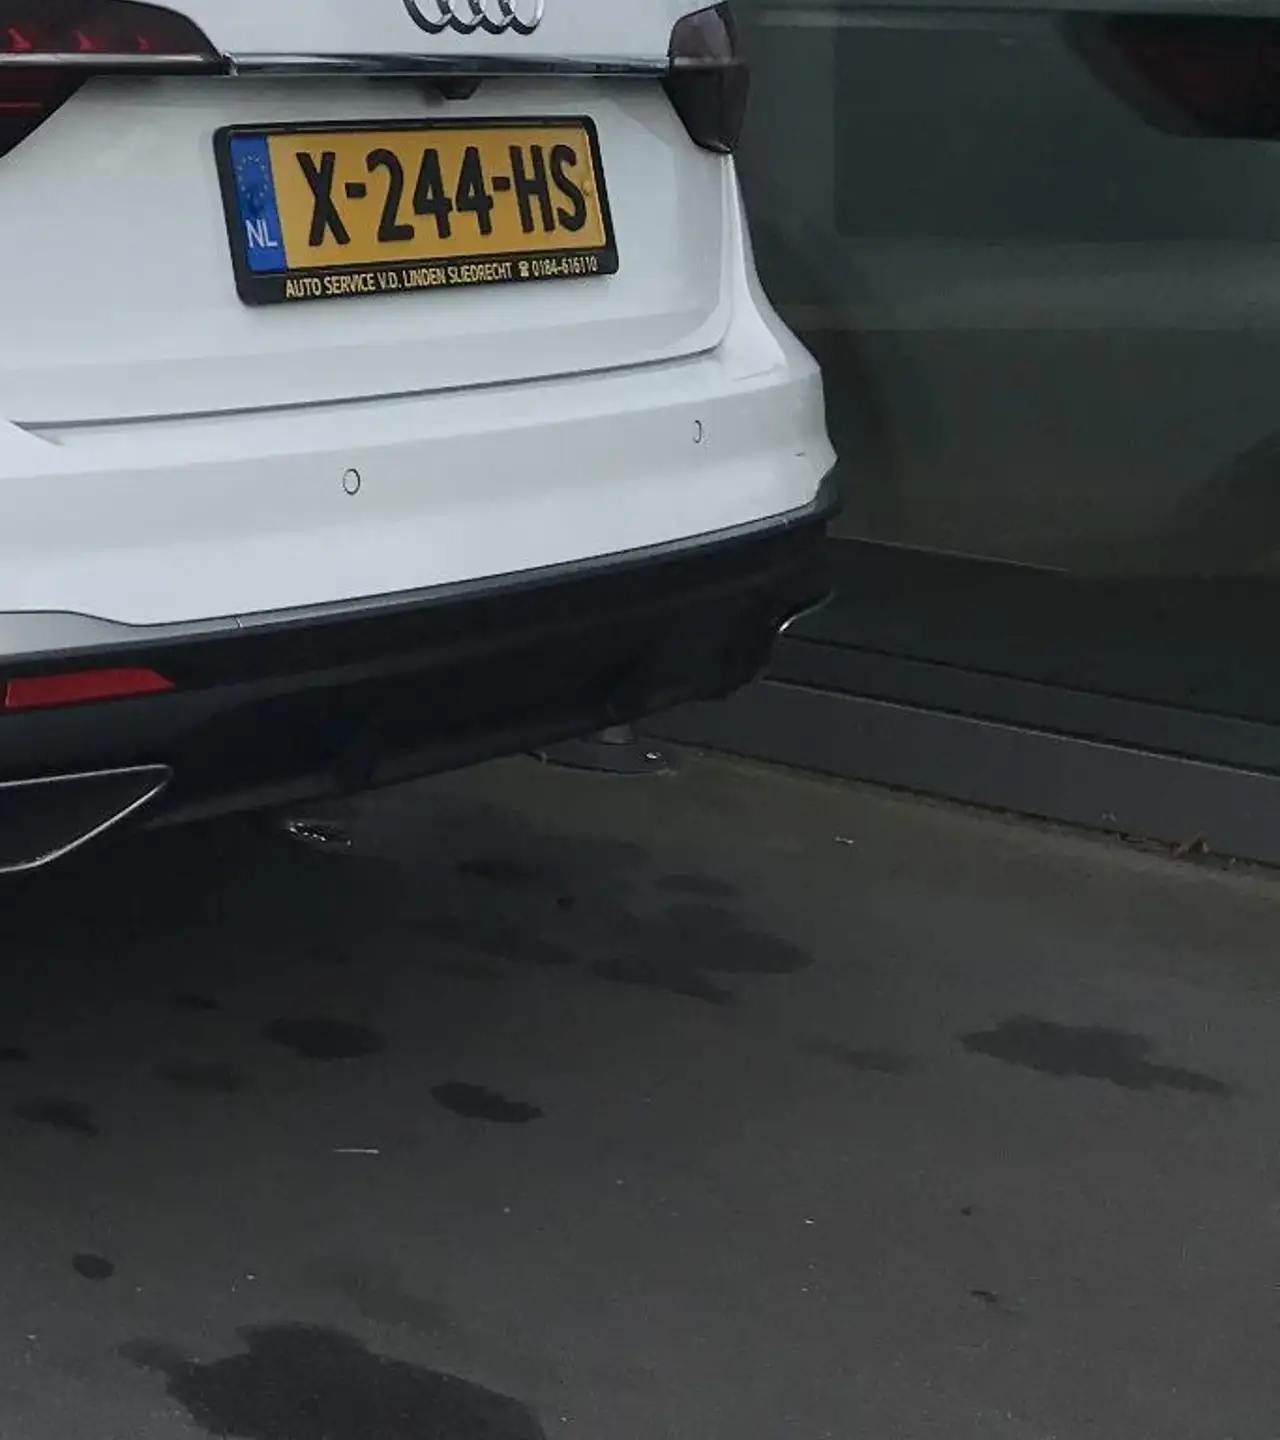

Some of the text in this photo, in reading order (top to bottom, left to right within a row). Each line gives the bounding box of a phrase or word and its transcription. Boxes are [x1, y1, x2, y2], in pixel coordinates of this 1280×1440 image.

[246, 144, 589, 248] NL X-244-HS
[285, 278, 321, 298] AUTO
[324, 273, 376, 295] SERVICE
[377, 271, 402, 289] V.D.
[403, 267, 446, 287] LINDEN
[448, 262, 512, 284] SLIEDRECHT
